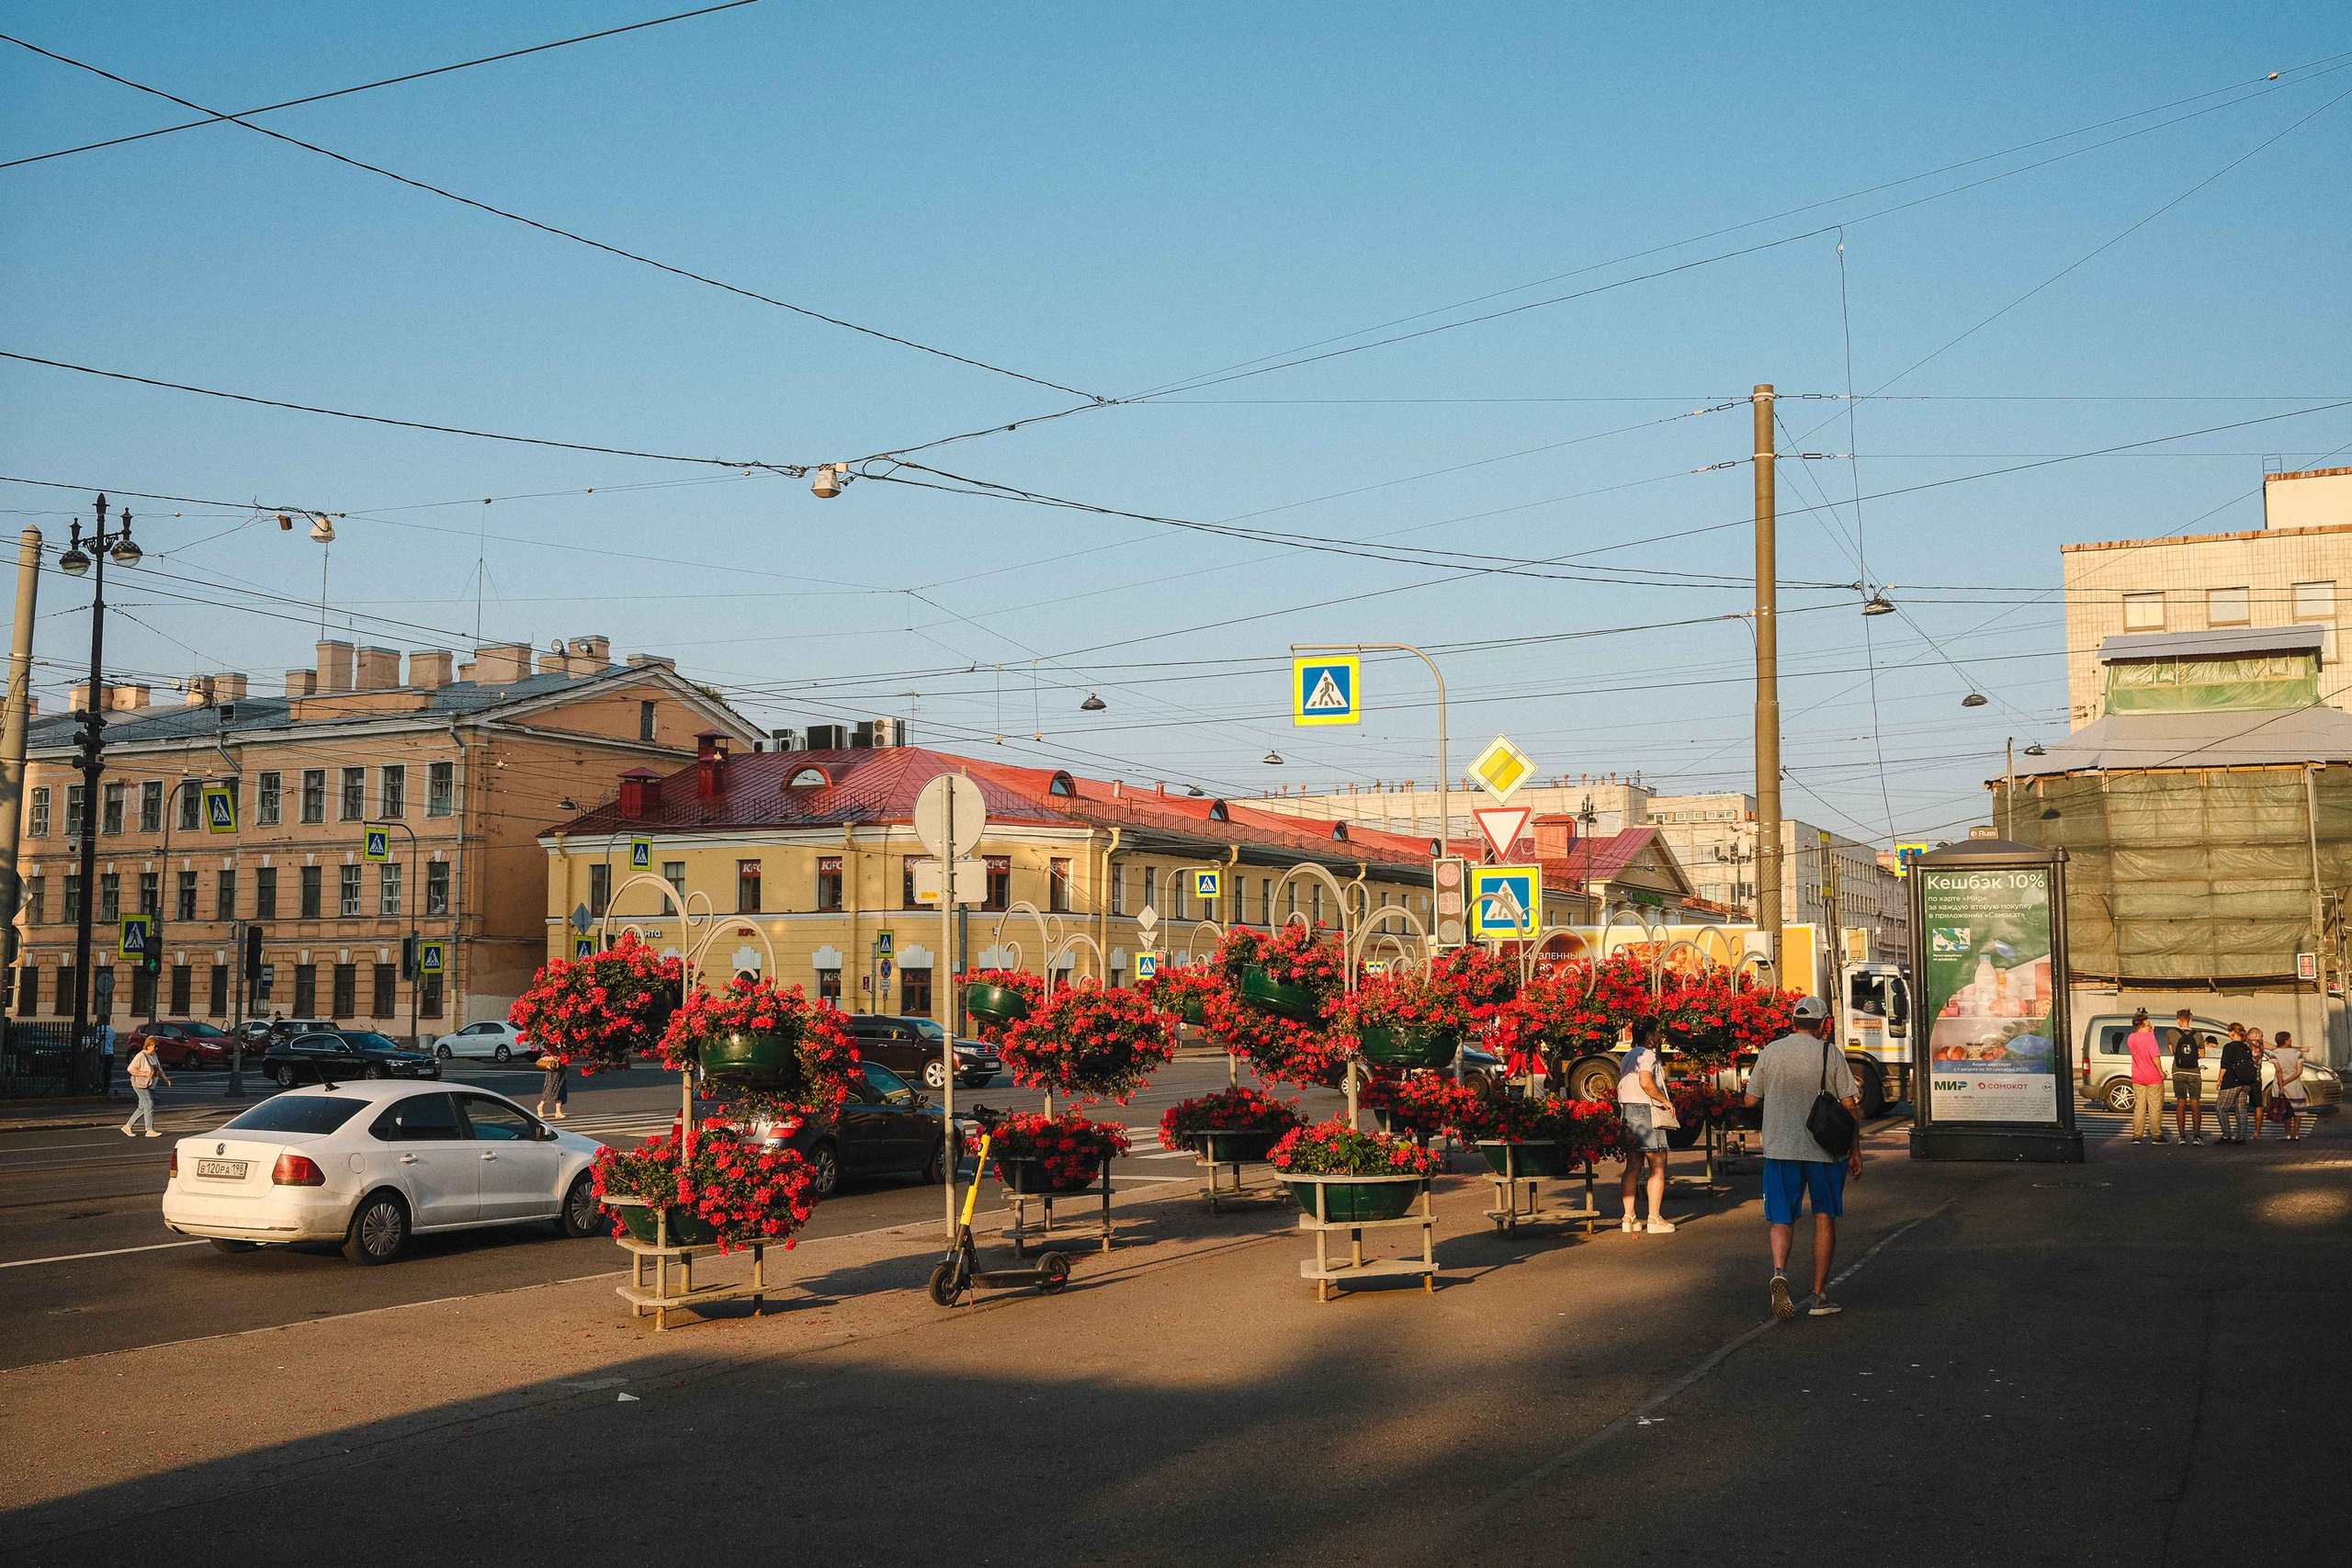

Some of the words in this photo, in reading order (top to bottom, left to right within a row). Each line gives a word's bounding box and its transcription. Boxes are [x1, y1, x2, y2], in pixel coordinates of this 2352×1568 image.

[1927, 874, 2002, 890] Кешбэк
[2007, 874, 2045, 888] 10%
[1934, 1080, 1968, 1091] МИР
